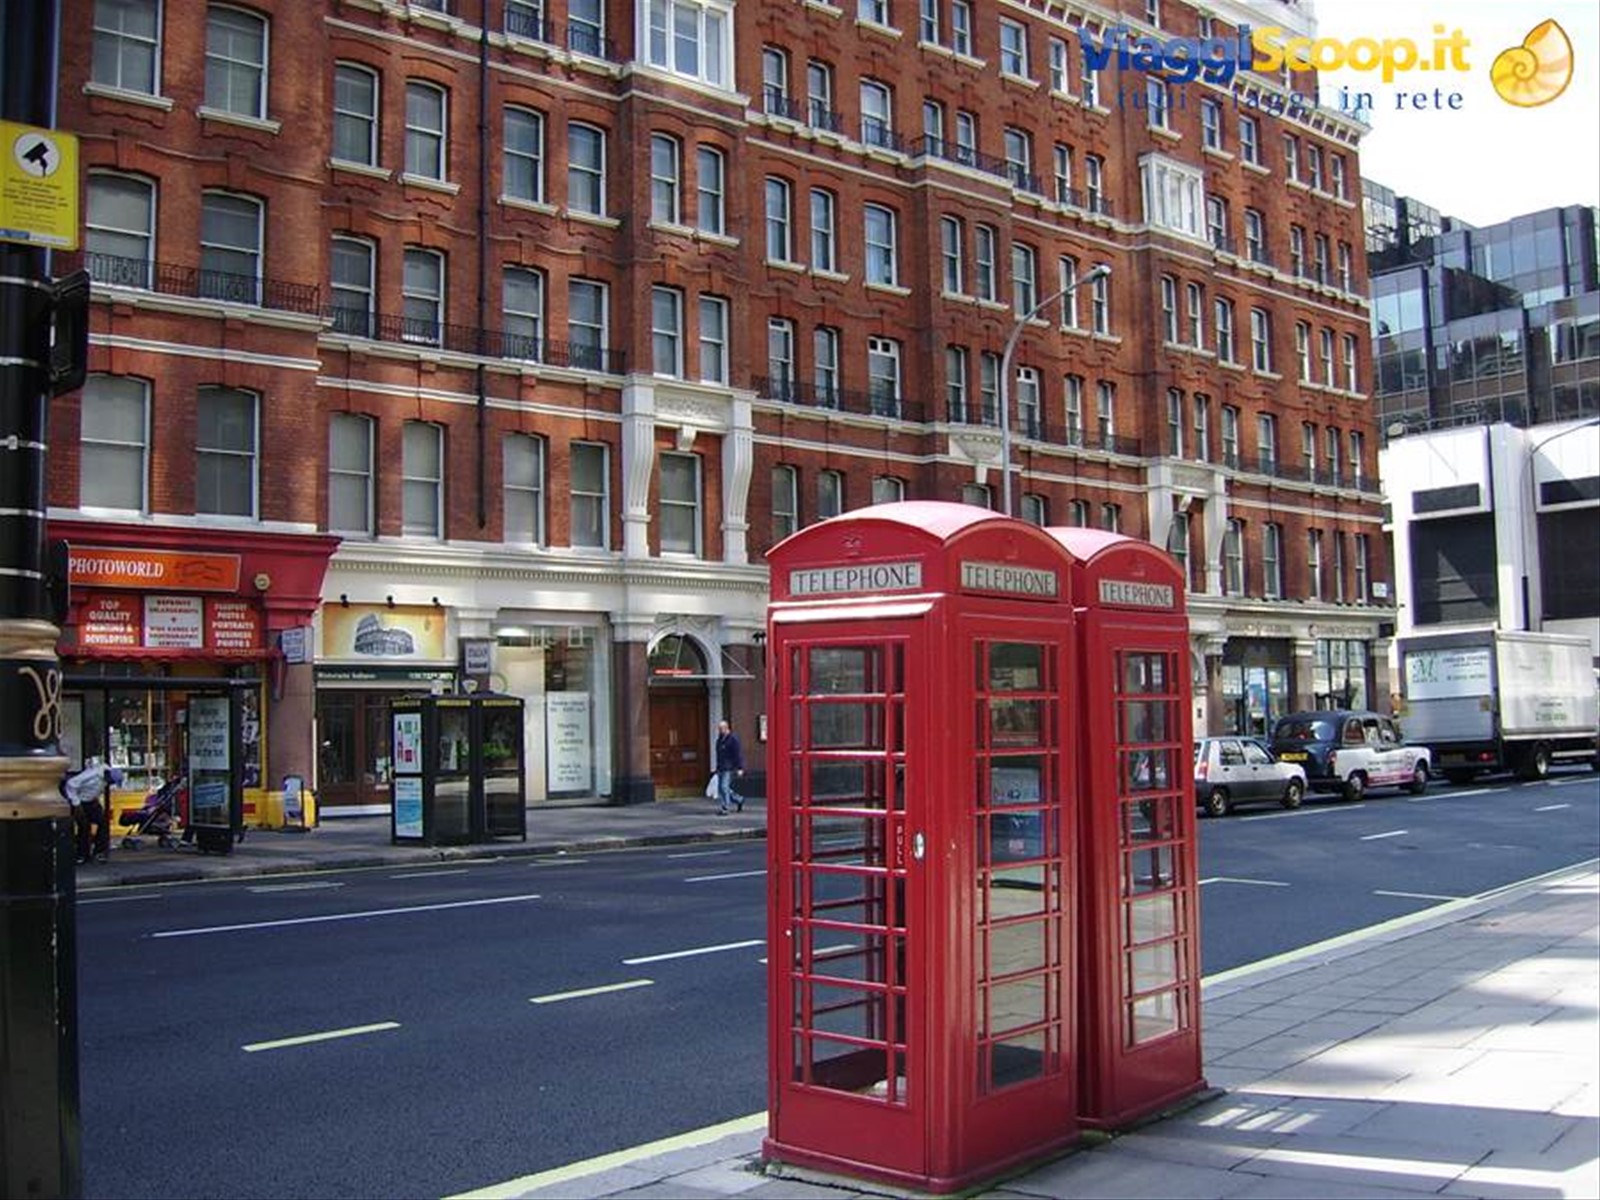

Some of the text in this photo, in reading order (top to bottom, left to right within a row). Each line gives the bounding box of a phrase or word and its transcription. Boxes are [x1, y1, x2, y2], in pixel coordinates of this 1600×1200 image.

[69, 557, 164, 578] PHOTOWORLD
[796, 564, 917, 593] TELEPHONE
[964, 565, 1053, 595] TELEPHONE
[100, 600, 120, 610] TOP
[1102, 582, 1171, 606] TELEPHONE
[89, 610, 131, 620] QUALITY
[896, 825, 904, 865] PULL
